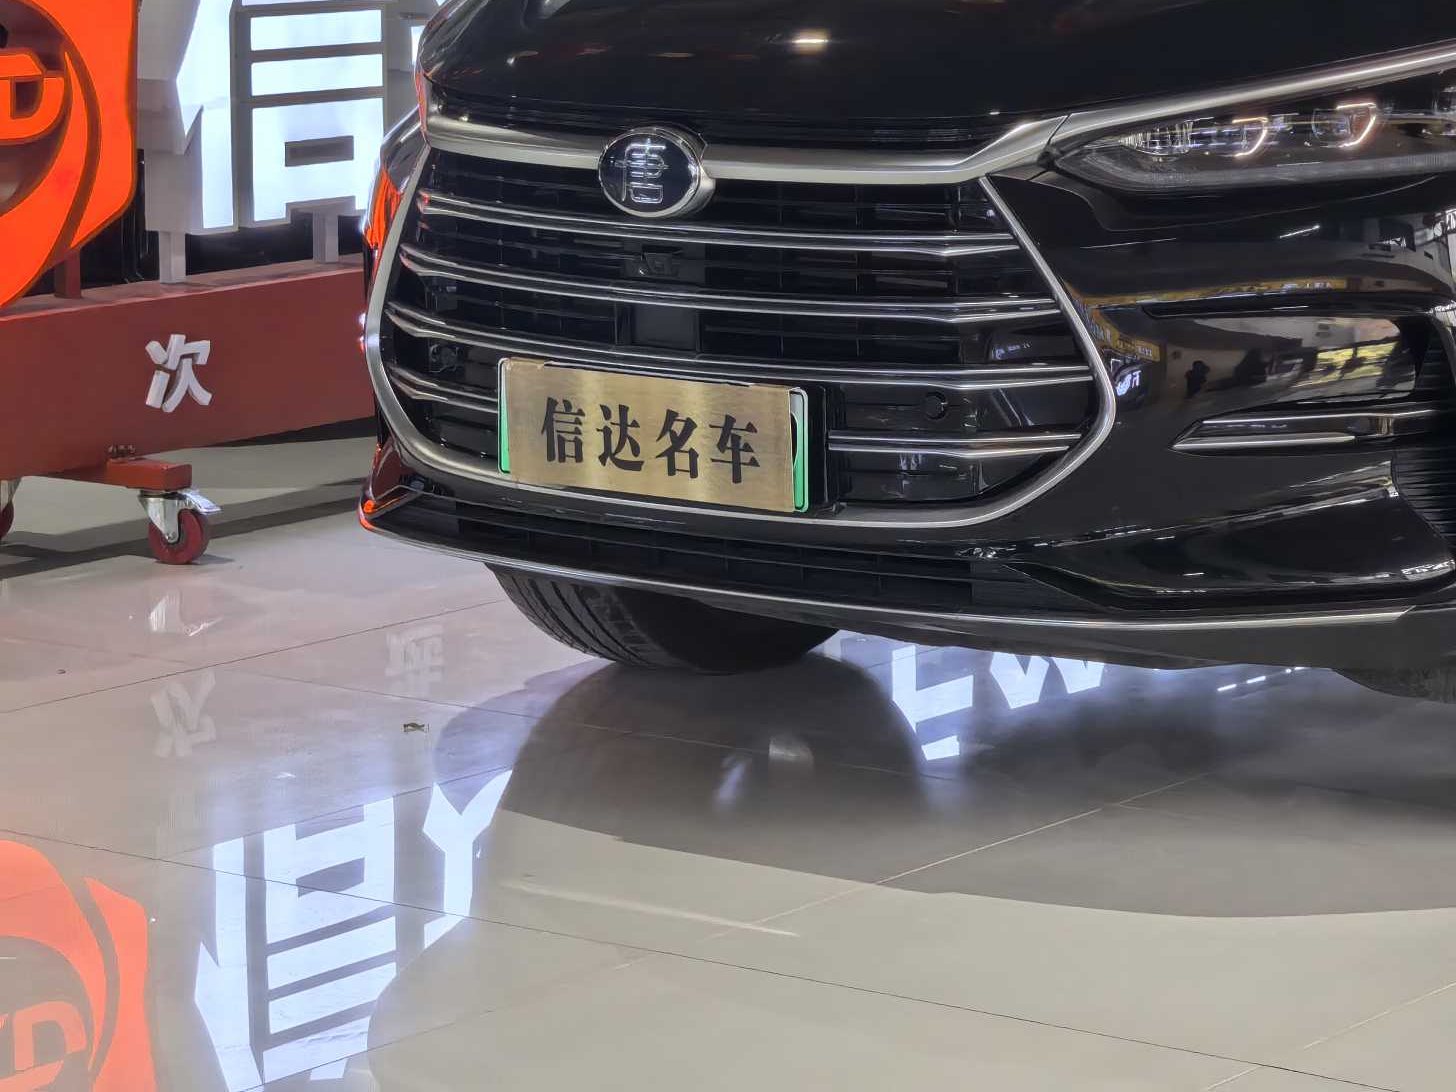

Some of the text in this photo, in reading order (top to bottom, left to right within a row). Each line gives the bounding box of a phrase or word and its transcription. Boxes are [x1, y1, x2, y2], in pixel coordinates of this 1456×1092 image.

[145, 333, 212, 413] 次
[540, 395, 762, 485] 信达名车
